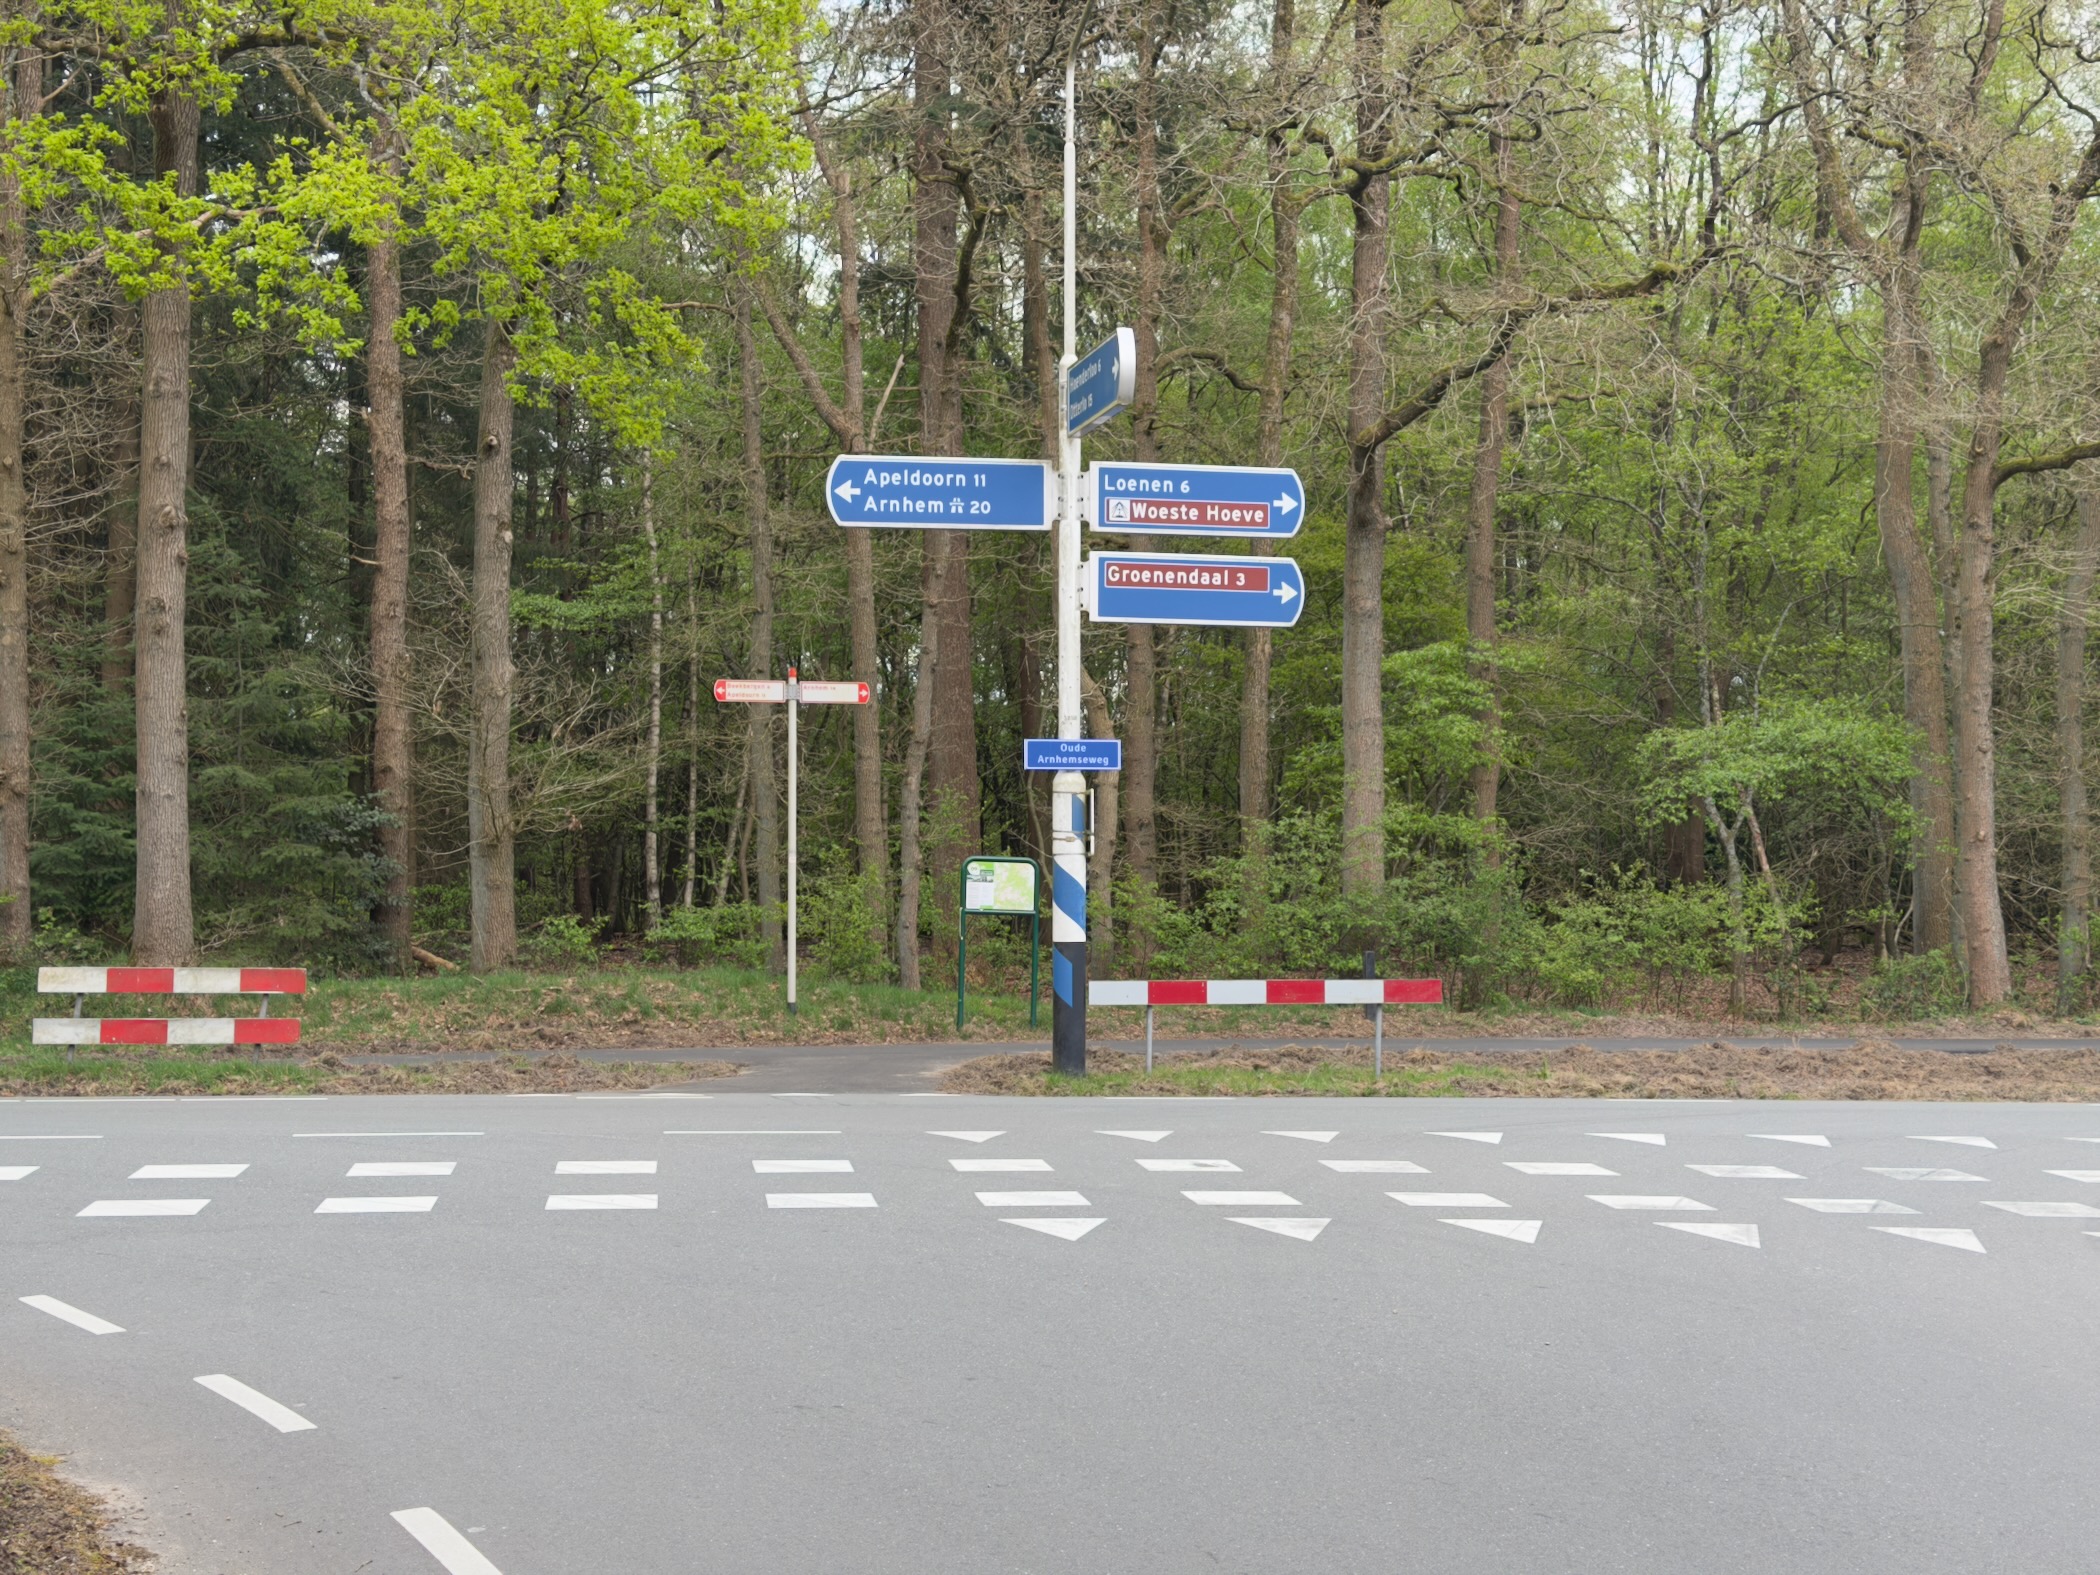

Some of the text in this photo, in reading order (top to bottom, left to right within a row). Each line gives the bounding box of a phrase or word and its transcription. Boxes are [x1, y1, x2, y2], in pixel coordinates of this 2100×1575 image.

[863, 468, 986, 488] Apeldoorn 11
[1104, 474, 1190, 493] Loenen 6
[863, 495, 991, 514] Arnhem 20
[1132, 502, 1264, 523] Woeste Hoeve
[1107, 565, 1246, 586] Groenendaal 3
[1060, 743, 1087, 752] Oude
[1037, 755, 1109, 766] Arnhemseweg
